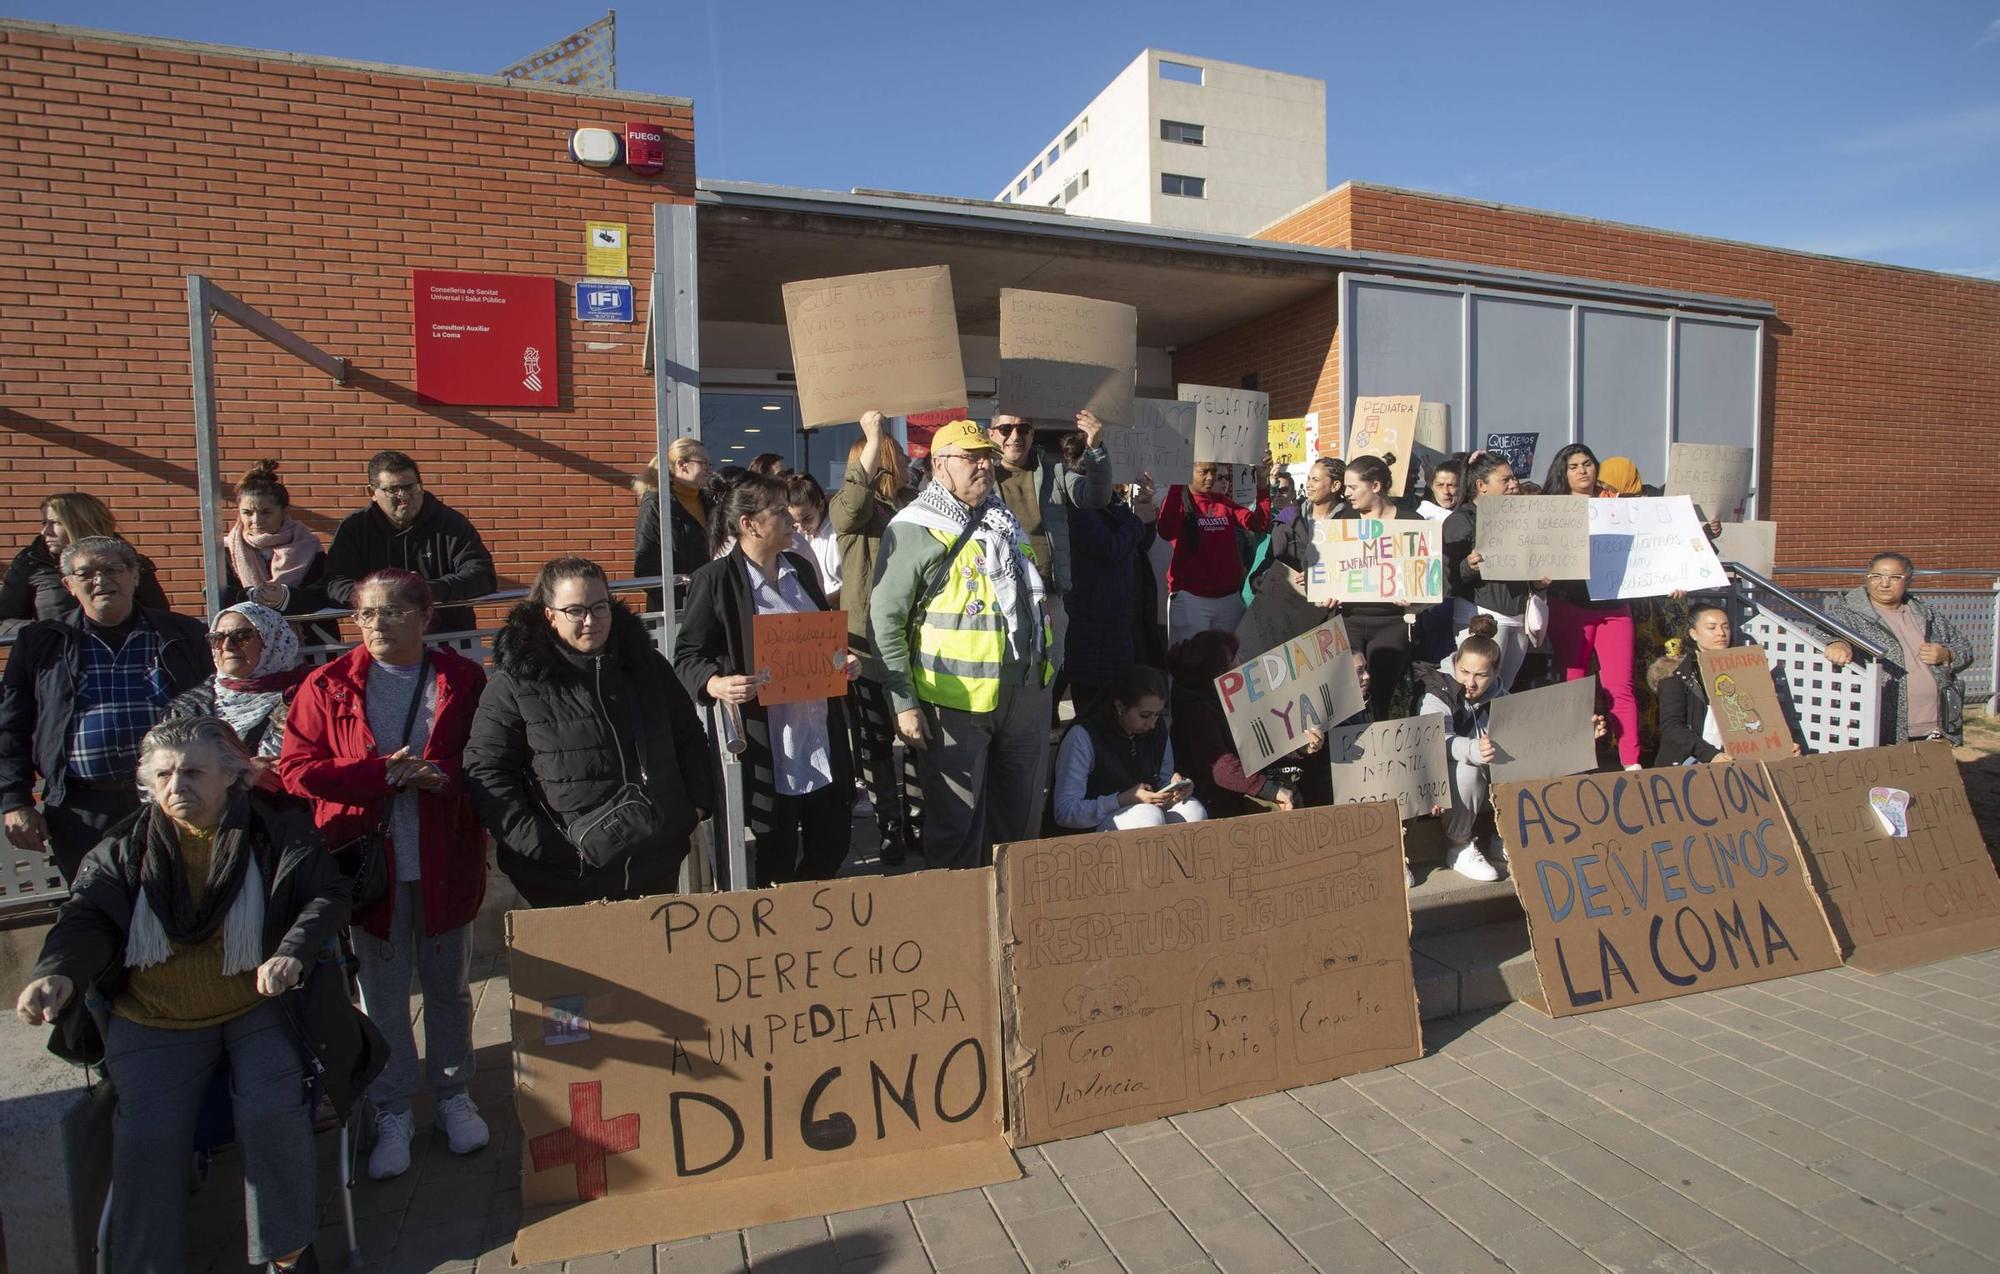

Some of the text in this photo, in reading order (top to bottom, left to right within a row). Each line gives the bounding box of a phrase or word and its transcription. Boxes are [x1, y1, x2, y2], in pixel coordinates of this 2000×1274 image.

[629, 131, 661, 142] FUEGO
[430, 294, 461, 302] Universal
[465, 295, 482, 303] Salut
[476, 288, 499, 296] Sanitat
[590, 291, 619, 307] IFI
[432, 324, 465, 332] Consultori
[442, 331, 461, 339] Coma
[1348, 569, 1379, 593] EL
[1380, 558, 1441, 598] BARRIO
[1218, 620, 1350, 714] PEDIATRA
[1727, 740, 1761, 754] PARA
[1778, 757, 1880, 807] DERECHO
[1021, 835, 1129, 908] PARA
[1136, 825, 1227, 889] UNA
[1534, 817, 1789, 922] DE VECINOS
[650, 887, 873, 954] POR SU
[1902, 873, 1998, 927] COMA
[1026, 895, 1211, 969] RESPETUOSA
[1554, 898, 1799, 1008] LA COMA
[713, 939, 923, 1003] DERECHO
[672, 988, 965, 1077] A UN PEDIATRA
[1068, 1030, 1114, 1063] Cero
